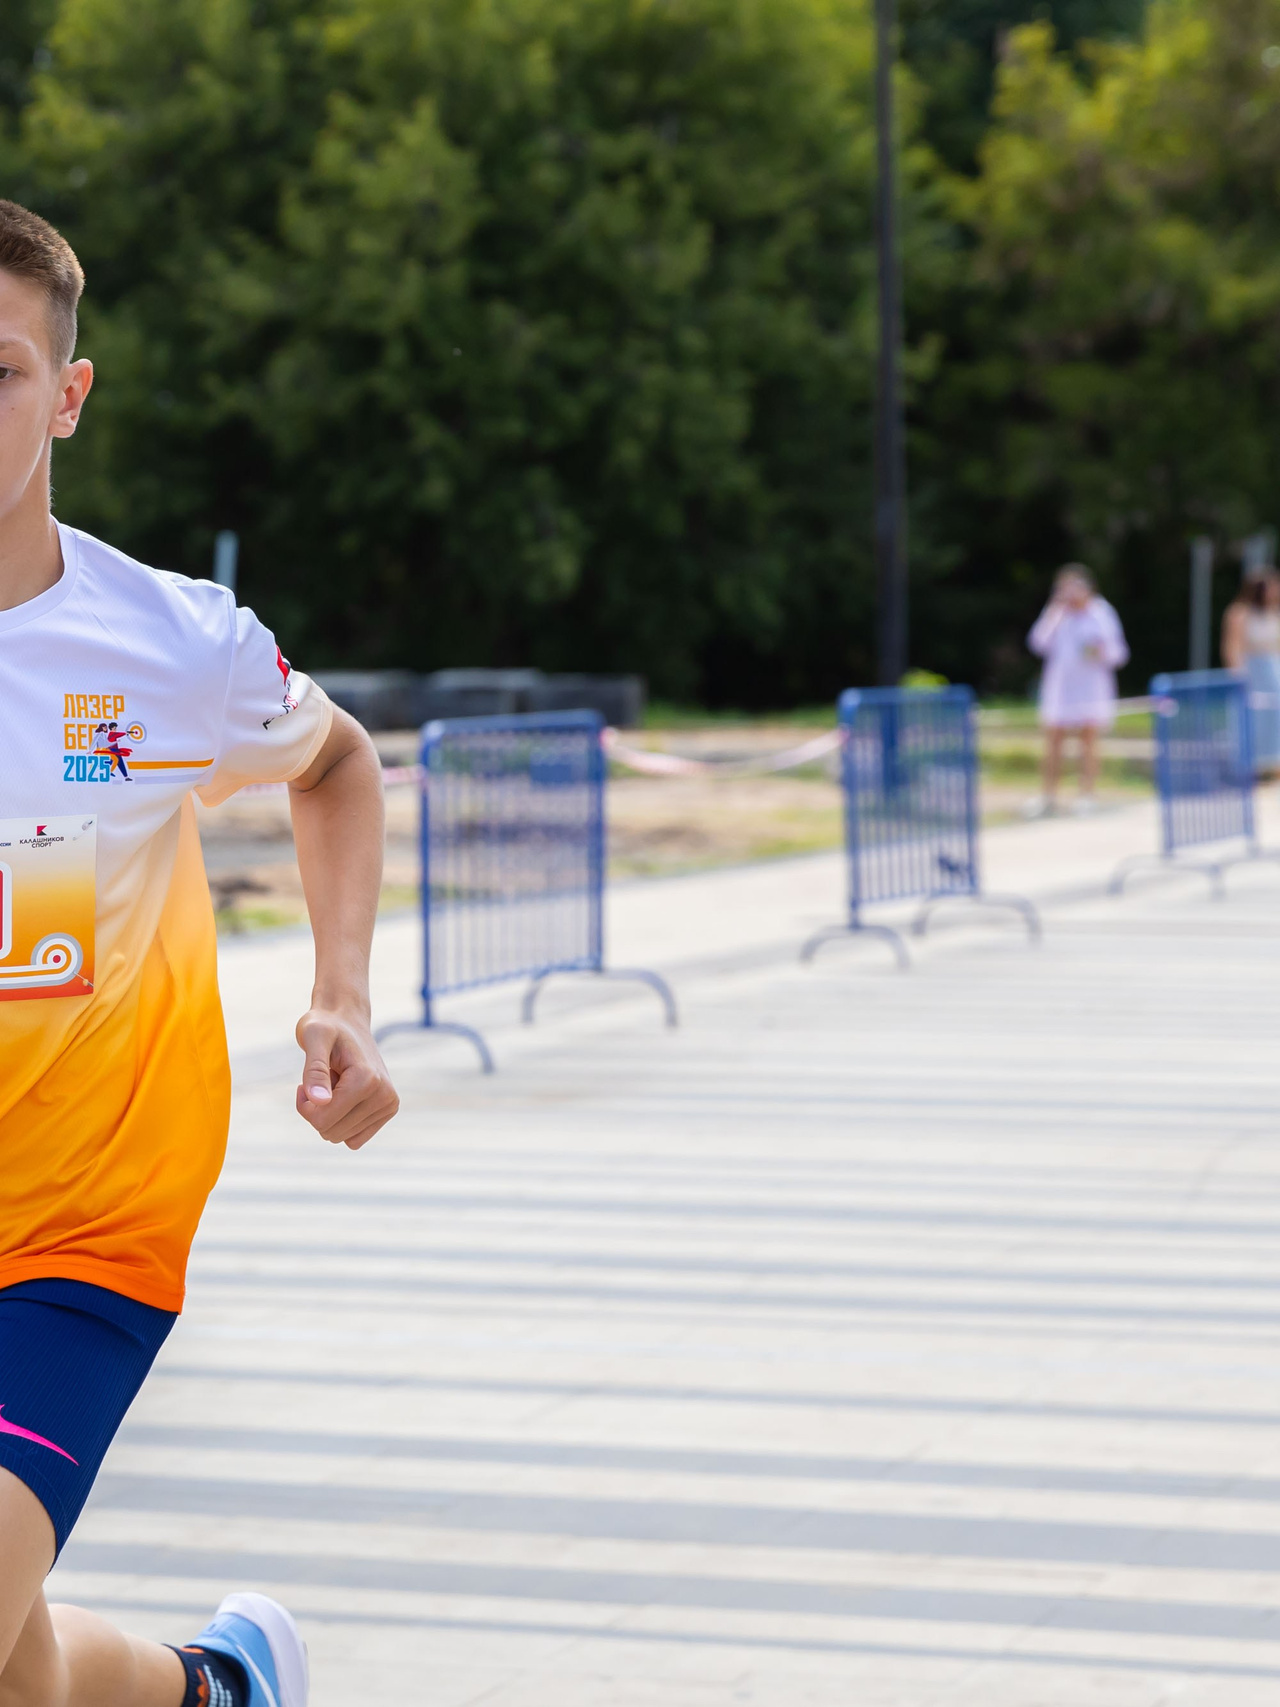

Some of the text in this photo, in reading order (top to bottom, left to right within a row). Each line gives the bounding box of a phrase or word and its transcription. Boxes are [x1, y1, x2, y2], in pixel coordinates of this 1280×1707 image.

[63, 693, 125, 720] ЛАЗЕР
[63, 755, 111, 783] 2025
[19, 836, 65, 844] КАЛАШНИКОВ
